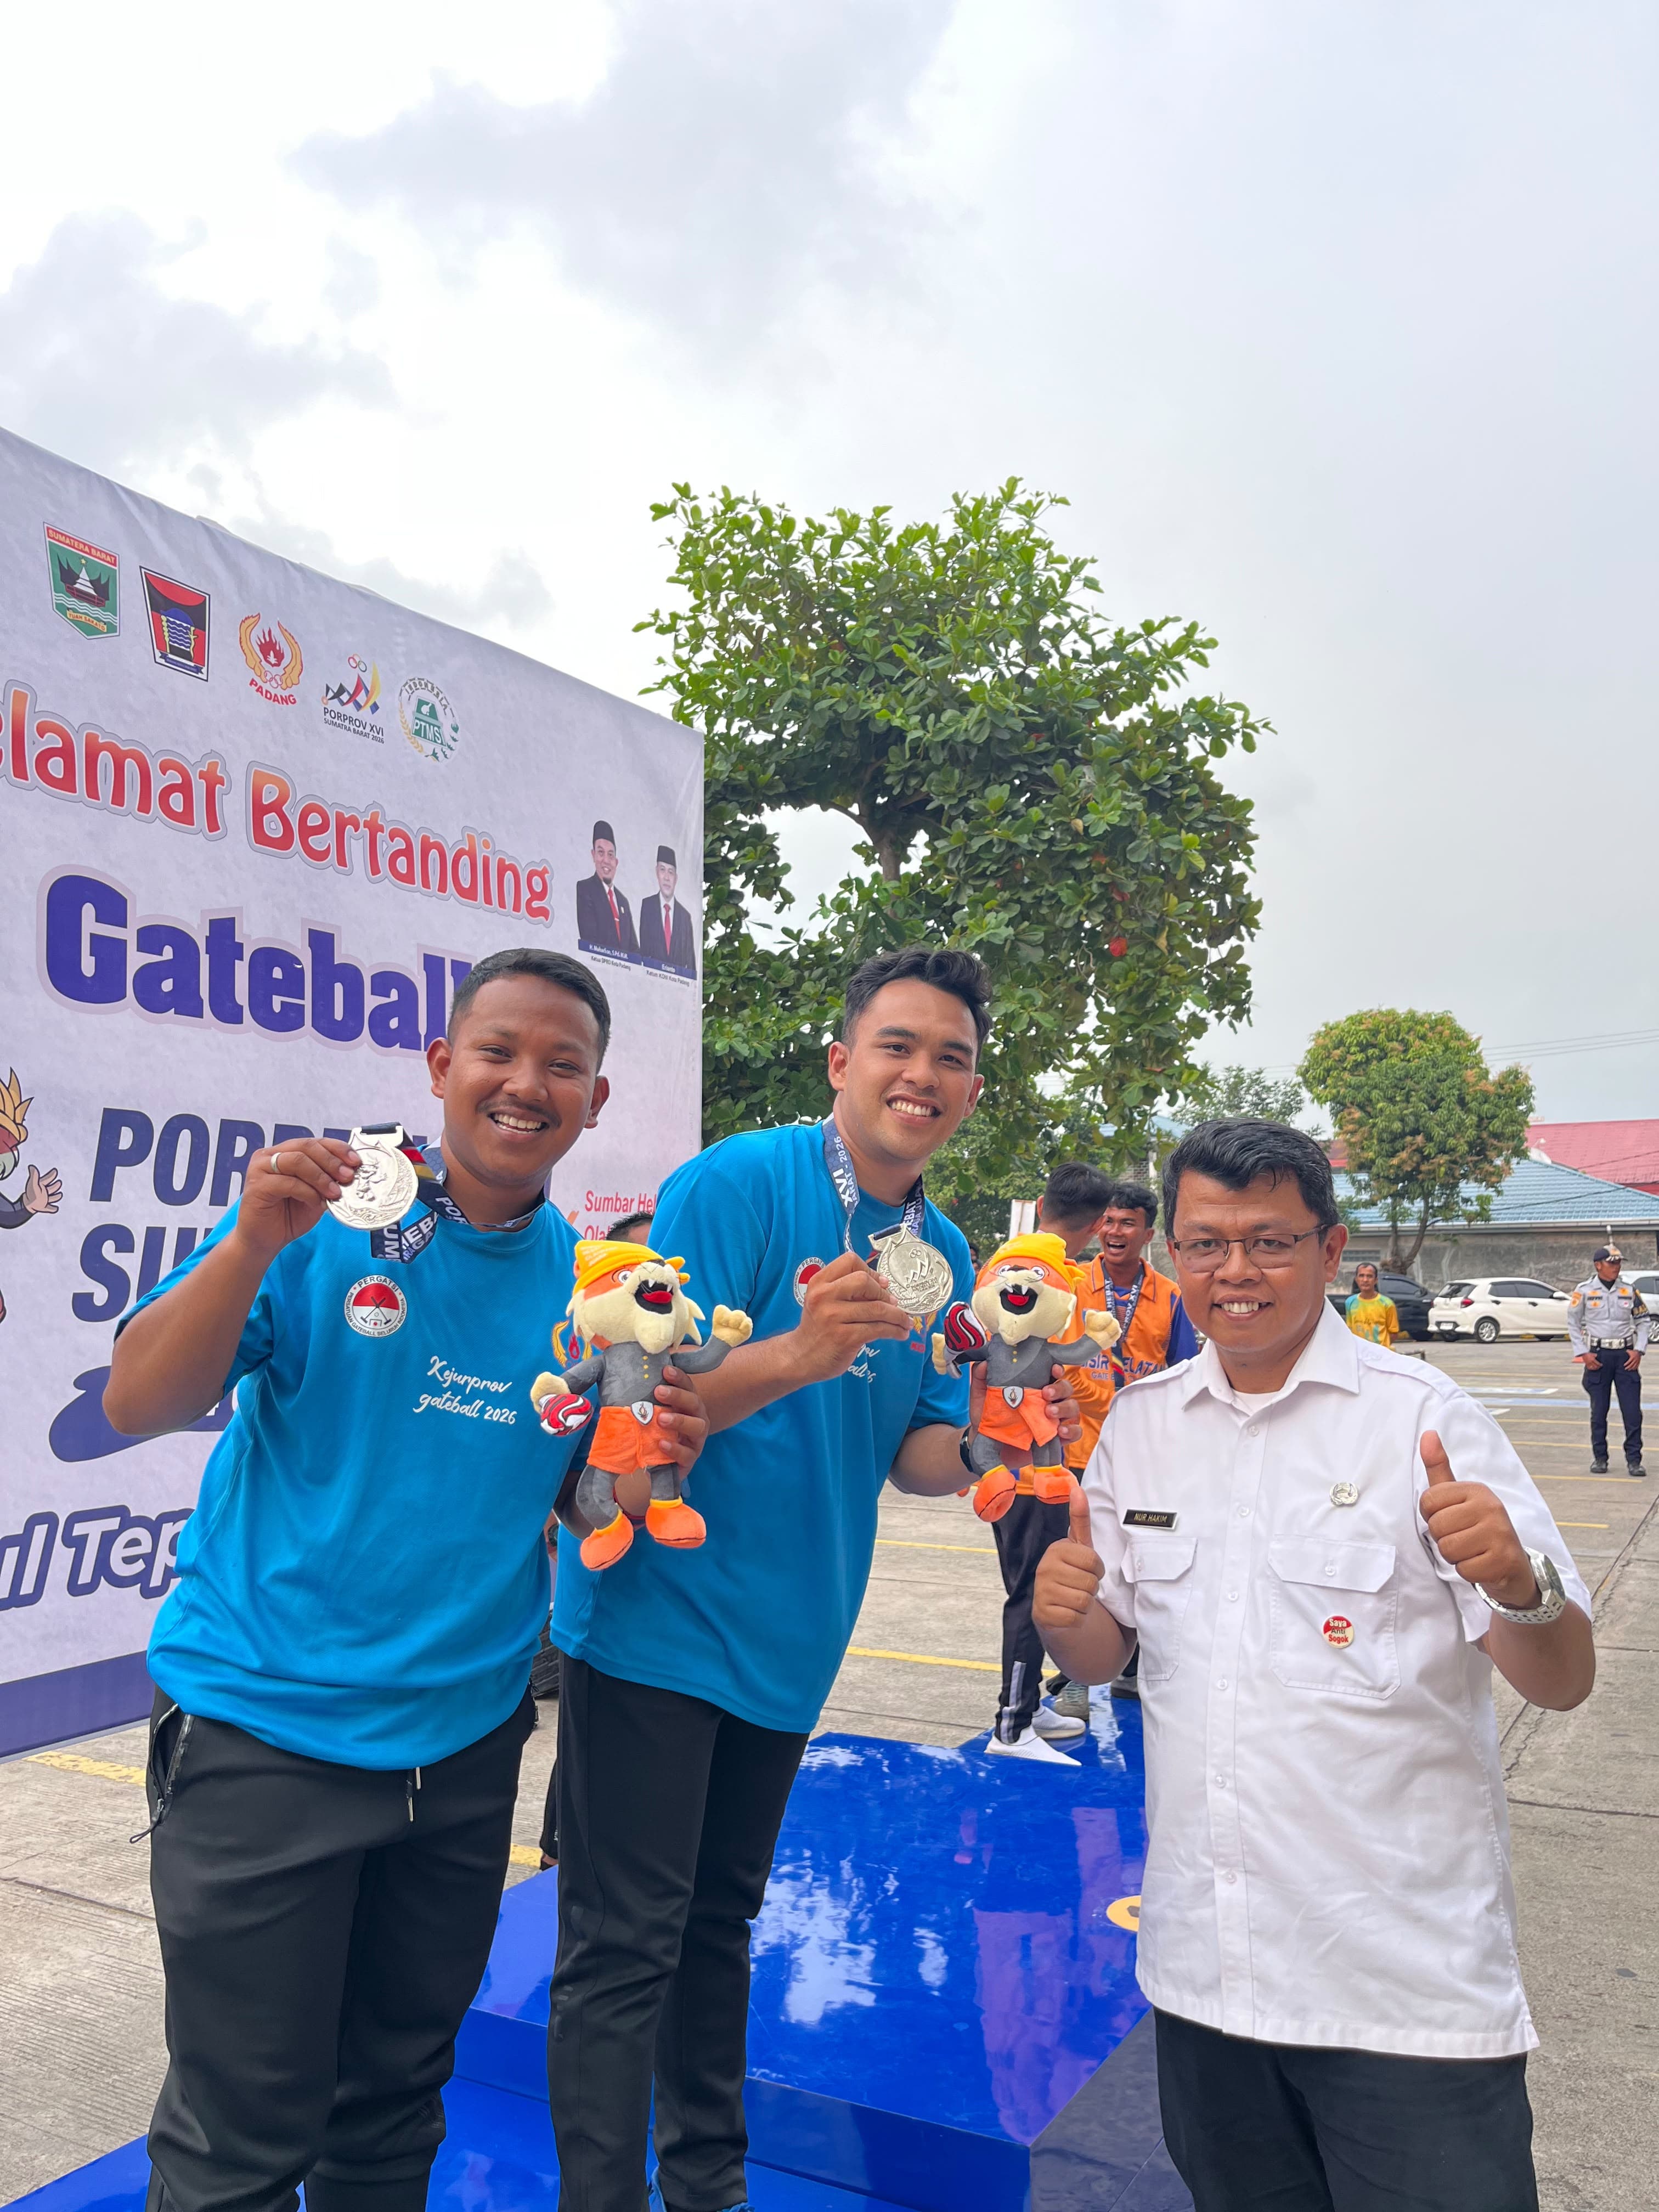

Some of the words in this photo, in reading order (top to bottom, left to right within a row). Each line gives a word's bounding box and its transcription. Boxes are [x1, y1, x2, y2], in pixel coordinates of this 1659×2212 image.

[48, 529, 89, 553] SUMATERA
[91, 548, 115, 564] BARAT
[249, 678, 297, 706] PADANG
[324, 707, 367, 730] PORPROV
[369, 723, 383, 737] XVI
[324, 718, 352, 732] SUMATRA
[353, 727, 370, 739] BARAT
[371, 734, 385, 744] 2026
[0, 689, 225, 833] lamat
[252, 769, 550, 922] Bertanding
[834, 1136, 848, 1163] 2026
[585, 1190, 635, 1212] Sumbar
[832, 1168, 853, 1208] XVI
[358, 1276, 399, 1292] PERGATSI
[346, 1292, 354, 1323] PERSATUAN
[352, 1322, 377, 1336] GATEBALL
[377, 1323, 399, 1336] SELURUH
[427, 1356, 512, 1395] Kejurprov
[413, 1391, 484, 1418] gateball
[484, 1406, 517, 1425] 2026
[1134, 1513, 1147, 1521] NUR
[1147, 1514, 1167, 1523] HAKIM
[1329, 1618, 1347, 1628] Saya
[1329, 1634, 1348, 1644] Sogok
